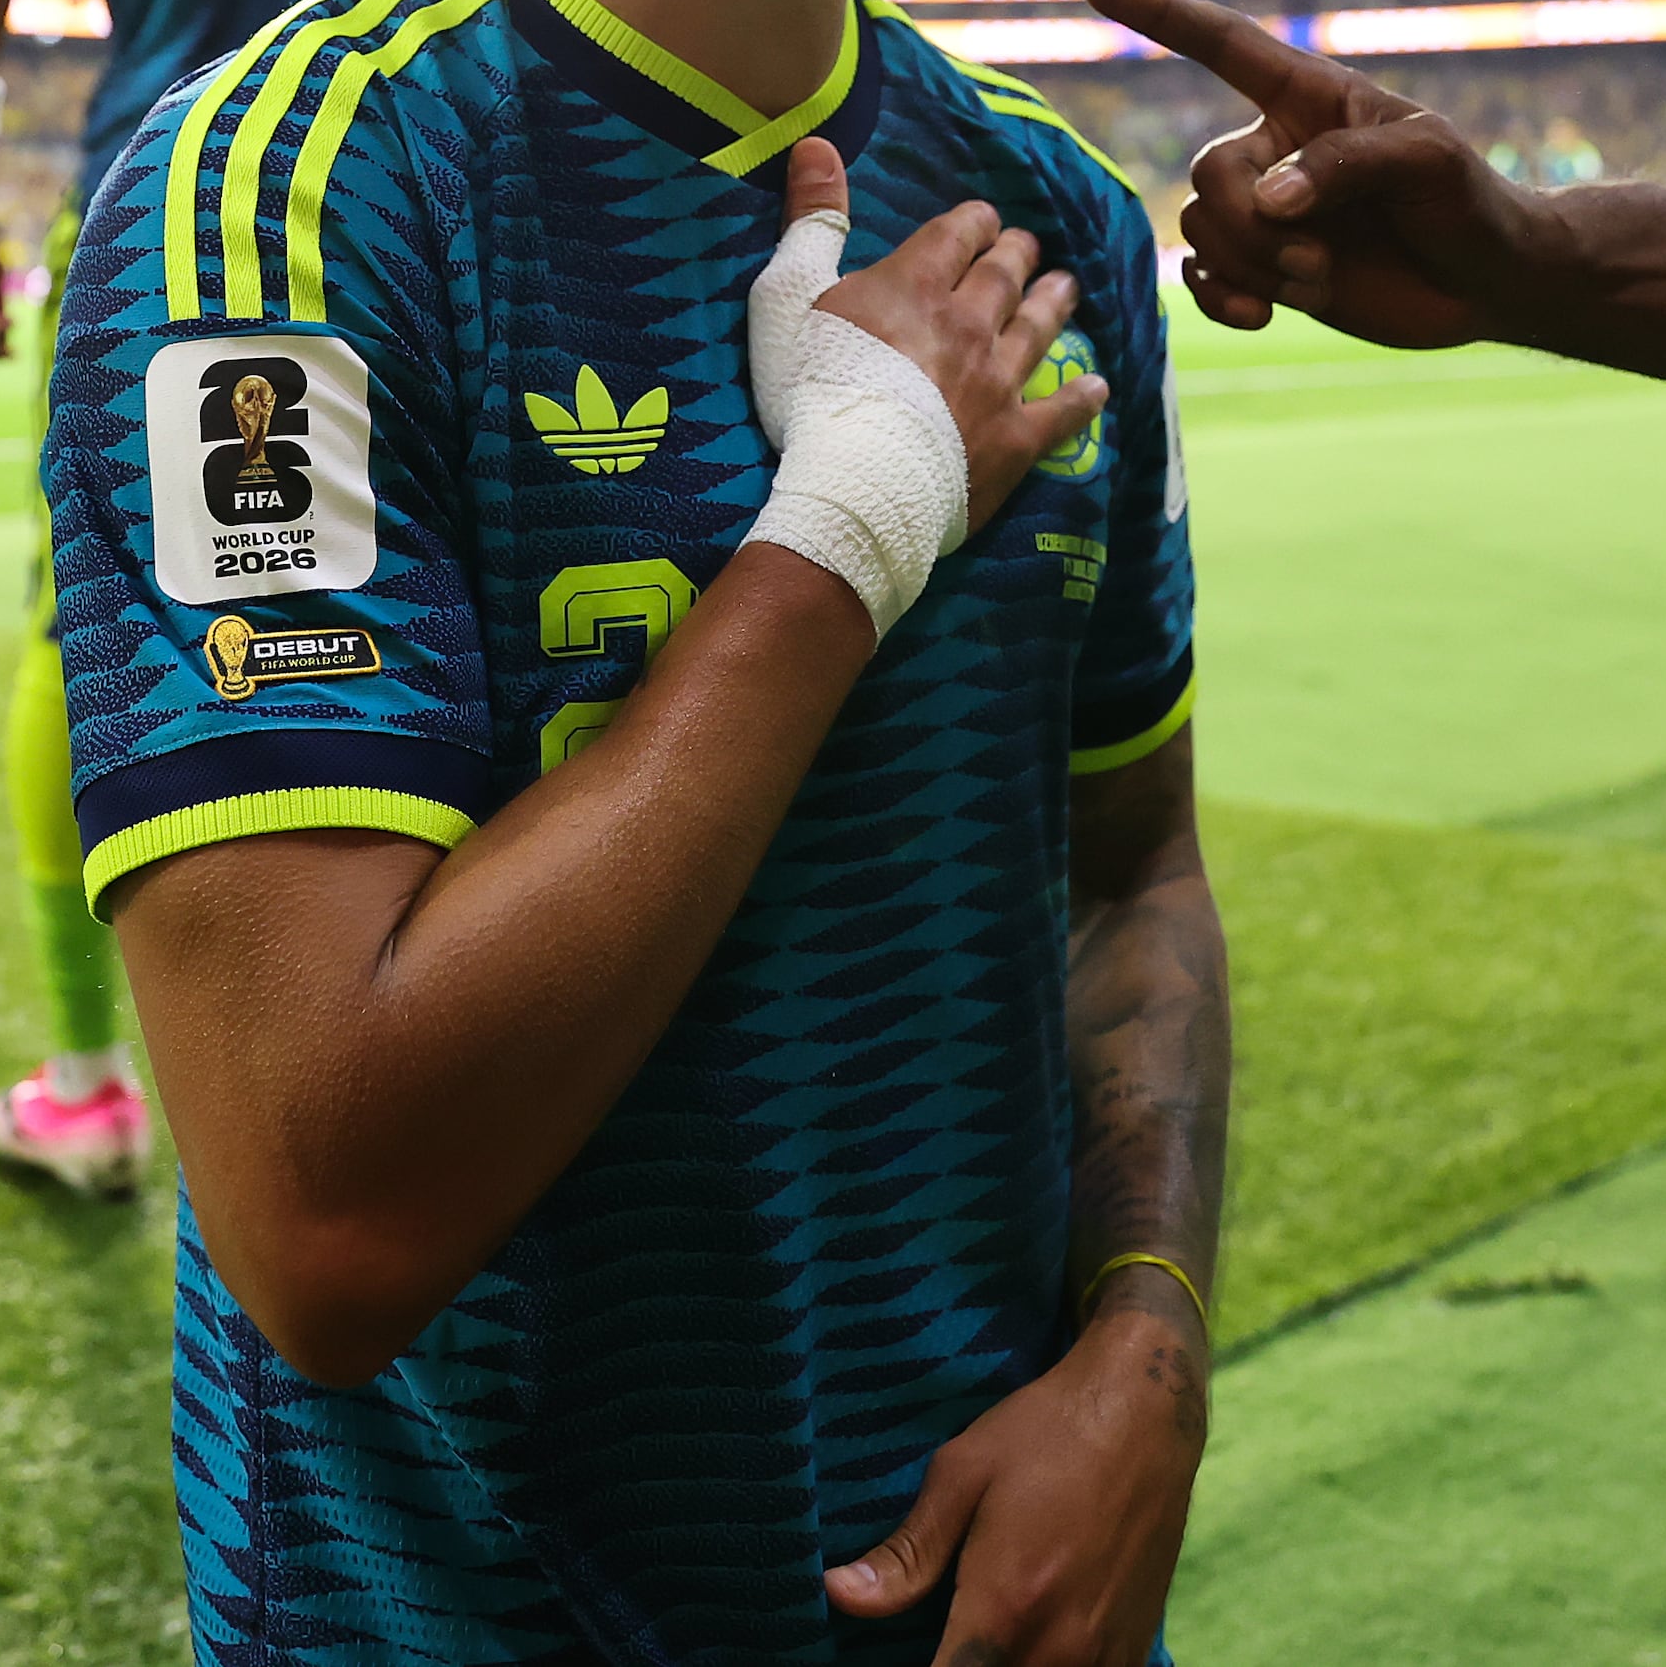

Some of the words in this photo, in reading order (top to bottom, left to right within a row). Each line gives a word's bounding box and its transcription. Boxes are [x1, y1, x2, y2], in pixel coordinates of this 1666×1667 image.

[234, 490, 284, 510] FIFA
[212, 532, 274, 551] WORLD
[278, 529, 315, 545] CUP
[214, 548, 317, 578] 2026
[253, 636, 360, 659] DEBUT
[261, 660, 287, 671] FIFA
[288, 656, 331, 668] WORLD
[332, 654, 357, 664] CUP
